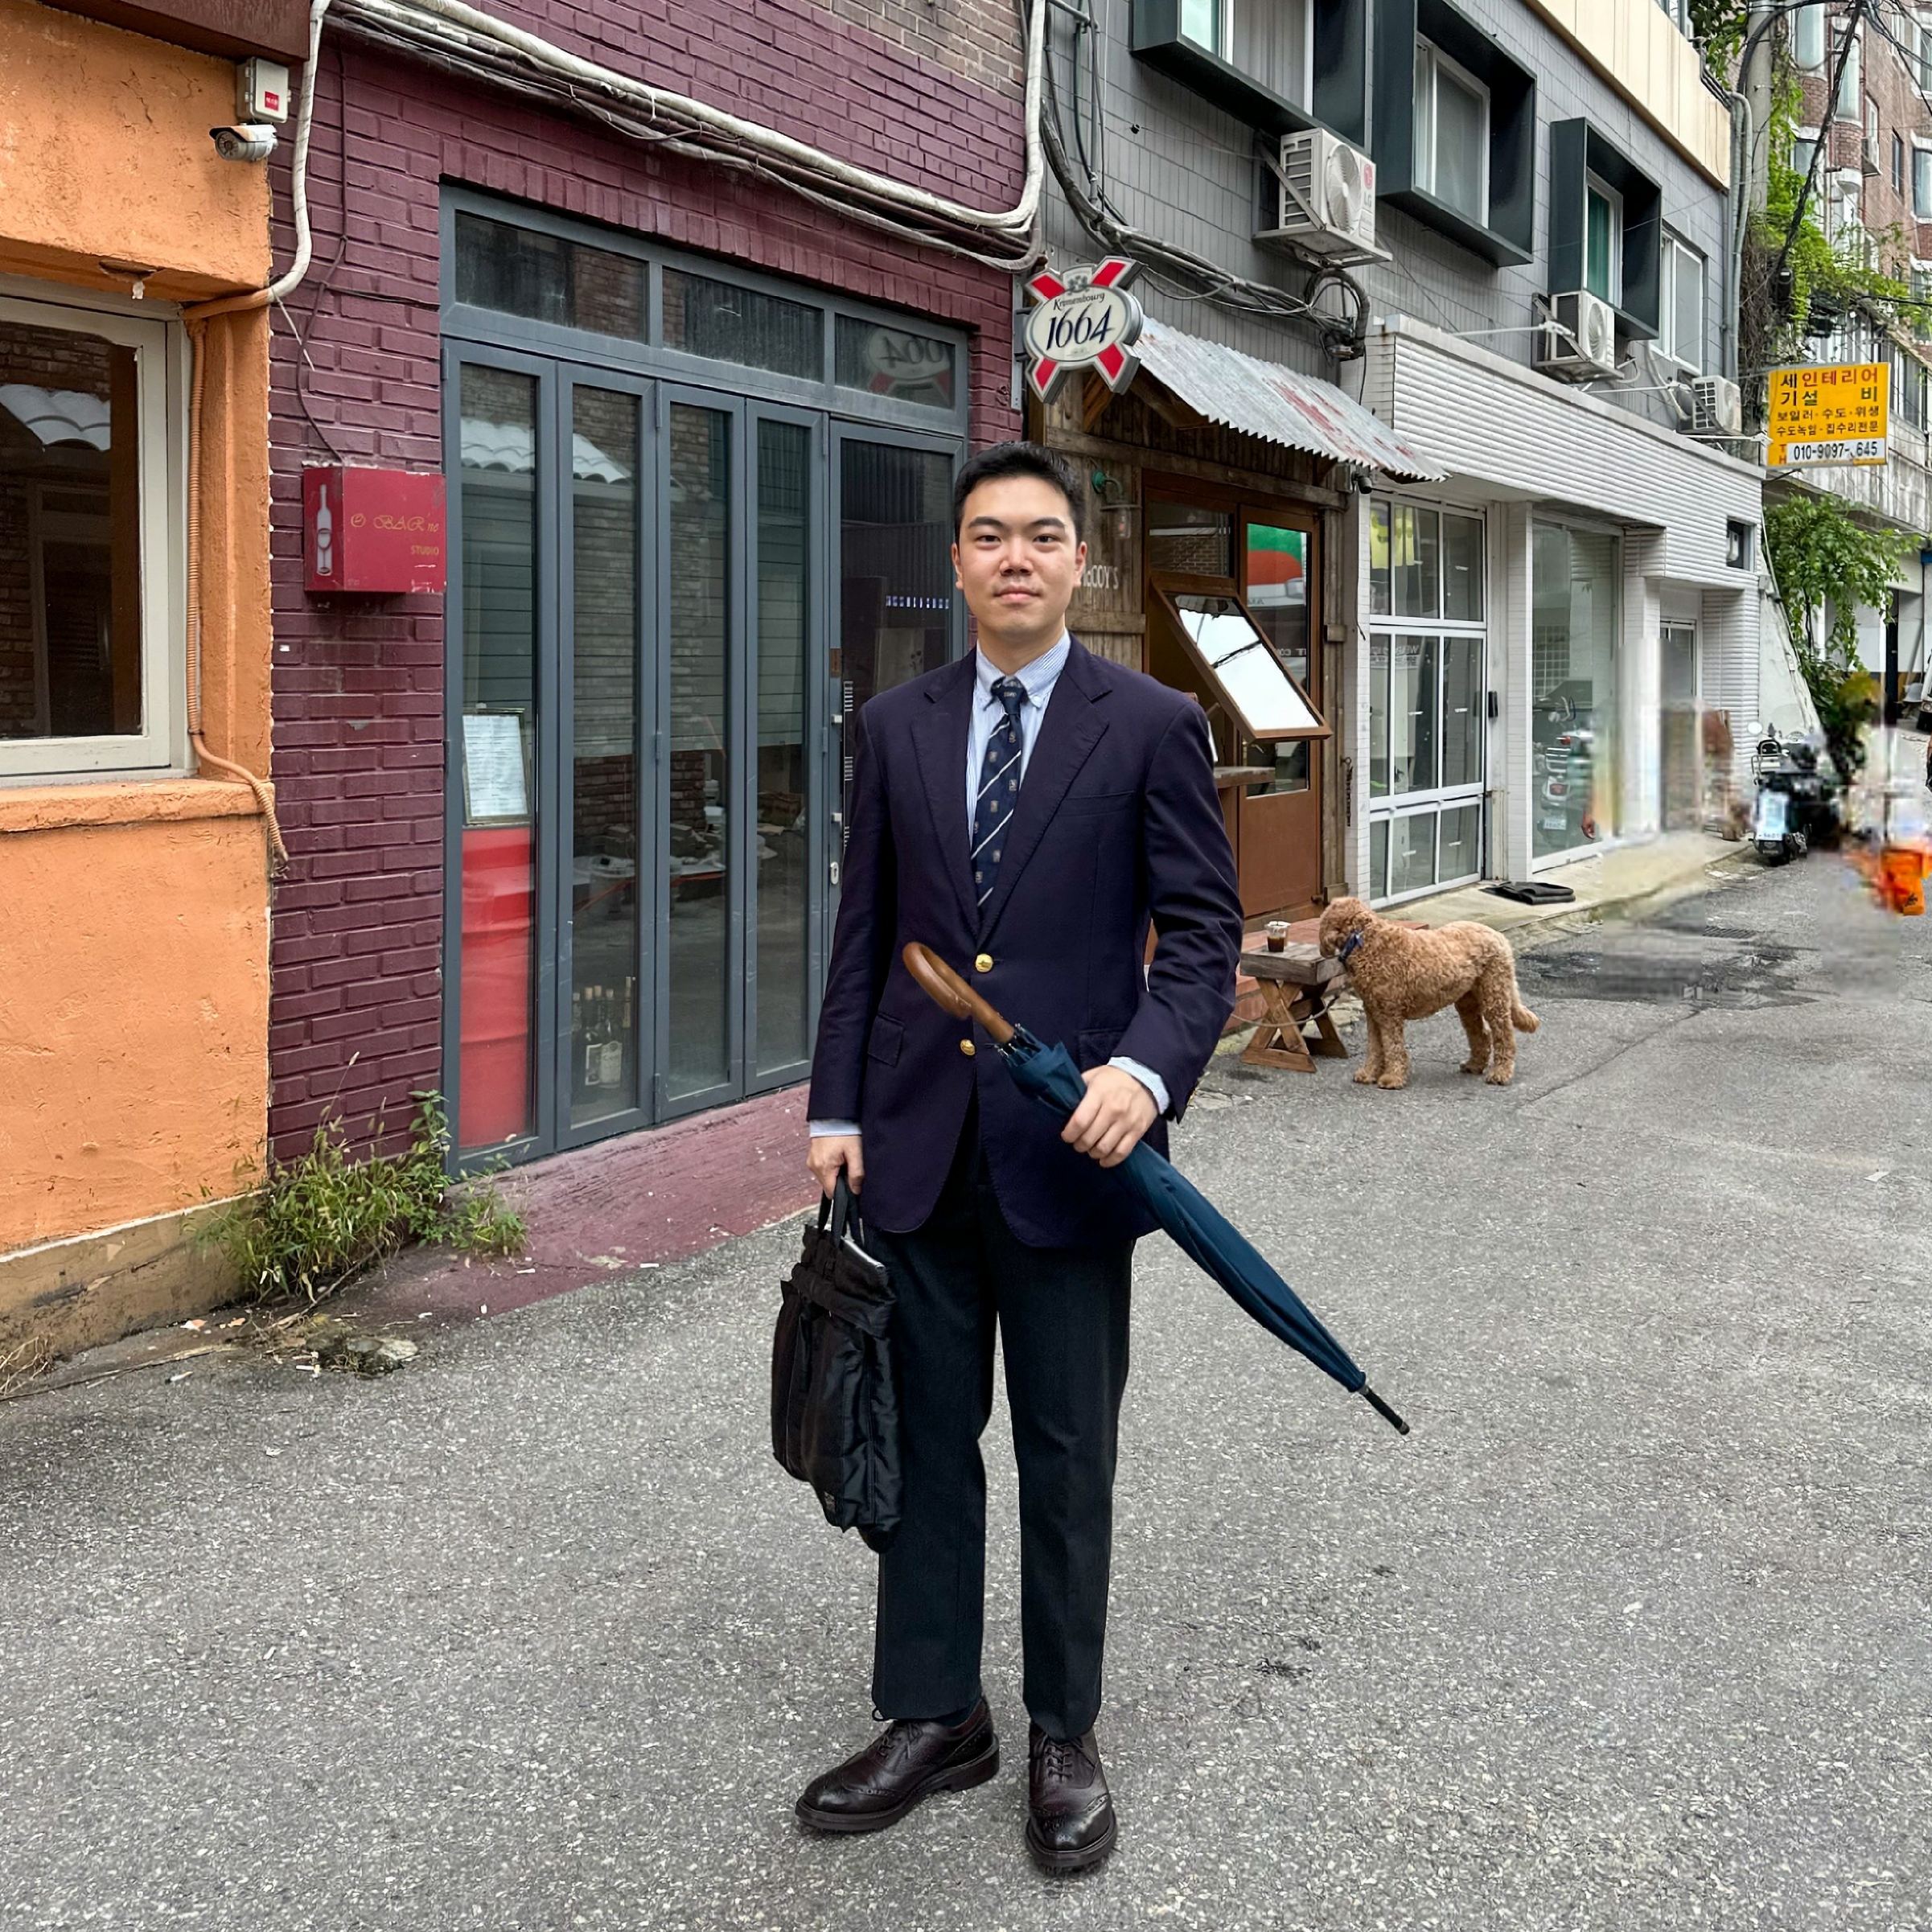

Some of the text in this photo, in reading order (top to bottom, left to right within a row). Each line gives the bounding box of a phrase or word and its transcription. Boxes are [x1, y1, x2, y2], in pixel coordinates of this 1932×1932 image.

[1046, 303, 1116, 351] 1664
[1794, 441, 1878, 461] 010-9097-645
[410, 545, 439, 556] STUDIO
